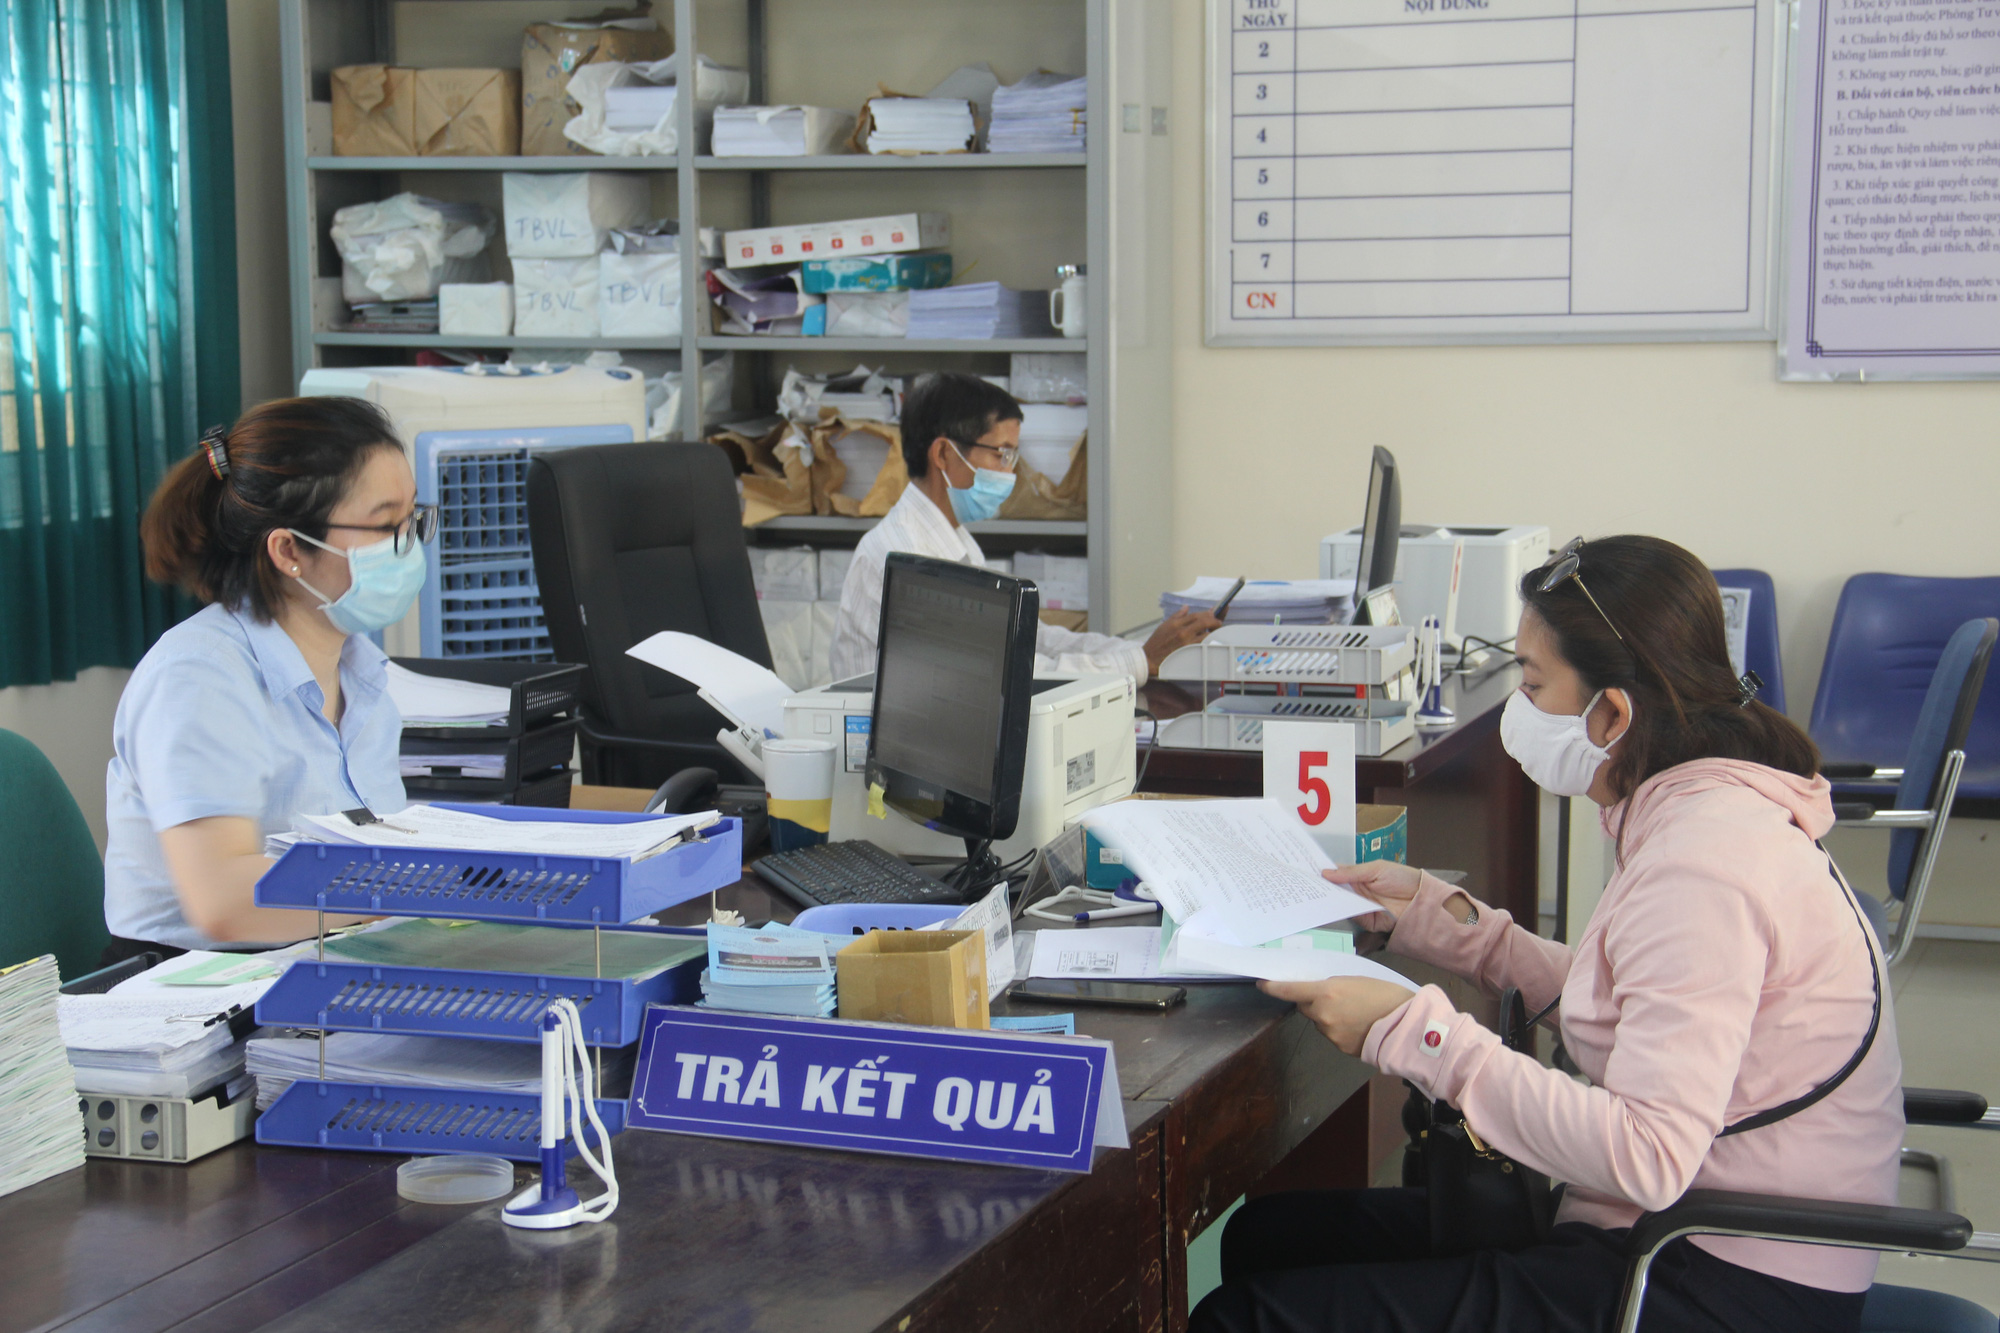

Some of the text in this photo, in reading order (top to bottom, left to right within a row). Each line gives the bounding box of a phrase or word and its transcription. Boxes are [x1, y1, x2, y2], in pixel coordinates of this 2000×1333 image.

[1242, 11, 1288, 27] NGÀY
[1865, 10, 1881, 24] kết
[1905, 10, 1936, 22] thuộc
[1939, 8, 1974, 21] Phòng
[1976, 7, 1992, 18] Tư
[1839, 35, 1849, 45] 4.
[1889, 32, 1900, 45] bị
[1956, 31, 1969, 40] sơ
[1971, 28, 1995, 39] theo
[1259, 42, 1269, 58] 2
[1832, 50, 1866, 63] không
[1838, 71, 1847, 81] 5.
[1850, 69, 1886, 82] Không
[1888, 70, 1906, 81] say
[1256, 84, 1267, 100] 3
[1837, 90, 1848, 101] B.
[1851, 86, 1871, 100] Đối
[1874, 88, 1891, 99] với
[1893, 87, 1914, 99] cán
[1937, 85, 1961, 97] viên
[1963, 83, 1992, 95] chức
[1848, 106, 1877, 122] Chấp
[1878, 108, 1905, 120] hành
[1908, 106, 1931, 120] Quy
[1934, 102, 1953, 117] chế
[1956, 105, 1977, 116] làm
[1256, 127, 1266, 143] 4
[1847, 125, 1863, 137] trợ
[1864, 124, 1883, 135] ban
[1834, 145, 1844, 156] 2.
[1847, 144, 1867, 156] Khi
[1870, 144, 1893, 156] thực
[1897, 142, 1920, 154] hiện
[1923, 141, 1958, 153] nhiệm
[1961, 142, 1975, 152] vụ
[1914, 158, 1926, 169] và
[1929, 157, 1949, 168] làm
[1951, 156, 1974, 168] việc
[1257, 168, 1269, 185] 5
[1833, 180, 1843, 191] 3.
[1845, 179, 1866, 191] Khi
[1868, 175, 1889, 191] tiếp
[1892, 177, 1911, 189] xúc
[1937, 173, 1968, 191] quyết
[1971, 175, 1999, 189] công
[1857, 194, 1870, 205] có
[1872, 193, 1892, 205] thái
[1894, 192, 1909, 206] độ
[1910, 192, 1937, 206] đúng
[1970, 190, 1990, 203] lịch
[1258, 211, 1269, 227] 6
[1830, 214, 1840, 225] 4.
[1843, 211, 1867, 227] Tiếp
[1870, 212, 1896, 226] nhận
[1915, 214, 1928, 223] sơ
[1956, 211, 1981, 221] theo
[515, 217, 577, 242] TBVL
[1823, 230, 1839, 242] tục
[1844, 229, 1867, 240] theo
[1870, 231, 1890, 243] quy
[1894, 227, 1919, 240] định
[1939, 224, 1961, 240] tiếp
[1823, 244, 1857, 256] nhiệm
[1261, 252, 1271, 269] 7
[1823, 259, 1846, 272] thực
[1829, 279, 1839, 290] 5.
[1858, 278, 1885, 292] dụng
[1887, 274, 1904, 289] tiết
[1906, 276, 1934, 289] kiệm
[1965, 277, 1993, 288] nước
[527, 291, 585, 312] TBVL
[606, 283, 677, 308] TBVL
[1246, 291, 1277, 310] CN
[1967, 291, 1985, 303] khi
[1986, 294, 1998, 303] ra
[1297, 751, 1331, 826] 5
[675, 1045, 1055, 1134] TRẢ KẾT QUẢ
